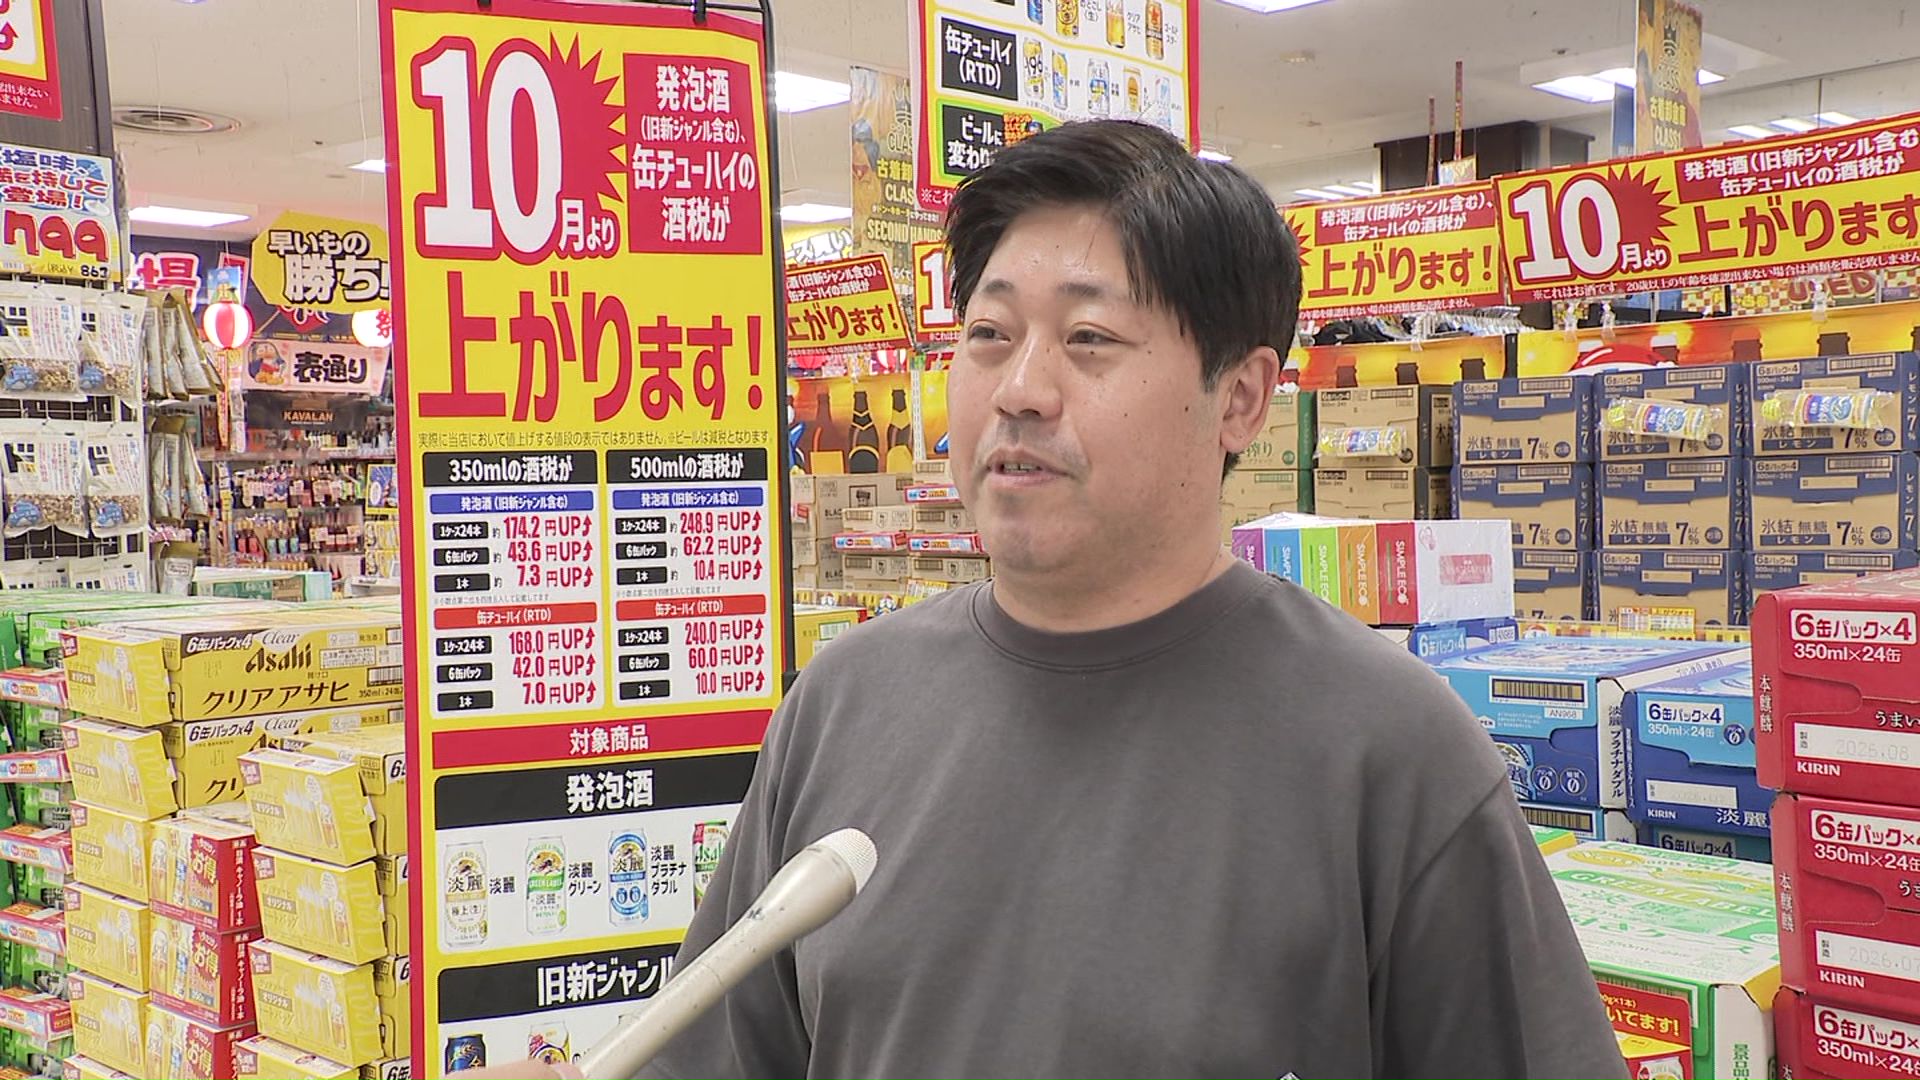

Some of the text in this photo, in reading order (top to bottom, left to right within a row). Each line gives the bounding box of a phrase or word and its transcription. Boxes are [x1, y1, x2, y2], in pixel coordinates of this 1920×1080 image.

[945, 25, 1013, 66] 缶チューハイ
[959, 56, 1001, 91] (RTD)
[656, 65, 730, 113] 発泡酒
[961, 114, 1003, 146] ビールに
[420, 48, 615, 254] 10月より
[947, 140, 998, 170] 変わり
[632, 147, 755, 191] 缶チューハイの
[1721, 152, 1904, 197] 缶チューハイの酒税が
[661, 196, 731, 243] 酒税が
[867, 219, 909, 242] SECOND
[1344, 214, 1467, 242] 缶チューハイの酒税が
[1514, 178, 1668, 281] 10月より
[1678, 194, 1920, 264] 上がります
[268, 231, 370, 255] 早いもの
[1308, 242, 1492, 298] 上がります！
[1788, 270, 1877, 304] UED
[418, 271, 763, 422] 上がります！
[294, 352, 367, 383] 表通り
[283, 411, 334, 422] KAVALAN
[1779, 439, 1817, 449] レモン
[449, 456, 573, 482] 350mlの酒税が
[630, 453, 744, 479] 500mlの酒税が
[825, 509, 842, 517] BLAC
[1761, 519, 1792, 534] 氷結
[1837, 522, 1852, 545] 7
[1623, 535, 1656, 544] レモン
[1777, 535, 1815, 545] レモン
[445, 551, 479, 563] 6缶パック
[1318, 545, 1329, 582] SIMPLE
[1356, 543, 1367, 580] SIMPLE
[1396, 540, 1407, 578] SIMPLE
[456, 577, 470, 590] 1本
[636, 571, 648, 582] 1本
[262, 631, 300, 646] Clear
[1795, 613, 1912, 641] 6缶パック×4
[245, 643, 312, 673] Asahi
[629, 658, 660, 670] 6缶パック
[1794, 643, 1901, 663] 350ml×24缶
[448, 668, 482, 681] 6缶パック
[203, 681, 350, 716] クリアアサヒ
[459, 696, 473, 708] 1本
[638, 685, 651, 696] 1本
[264, 716, 302, 731] Clear
[1550, 709, 1577, 719] AN968
[1648, 703, 1722, 725] 6缶パック×4
[569, 725, 648, 755] 対象商品
[1648, 723, 1716, 738] 350ml×24缶
[1797, 761, 1841, 776] KIRIN
[566, 769, 654, 814] 発泡酒
[1648, 809, 1676, 820] KIRIN
[1717, 808, 1769, 828] 淡麗
[651, 844, 674, 861] 淡麗
[568, 861, 593, 879] 淡麗
[651, 862, 687, 878] プラチナ
[489, 875, 516, 895] 淡麗
[568, 878, 602, 897] グリーン
[651, 880, 678, 896] ダブル
[1571, 872, 1672, 897] GREEN
[1670, 888, 1776, 918] LABEL
[1820, 970, 1865, 988] KIRIN
